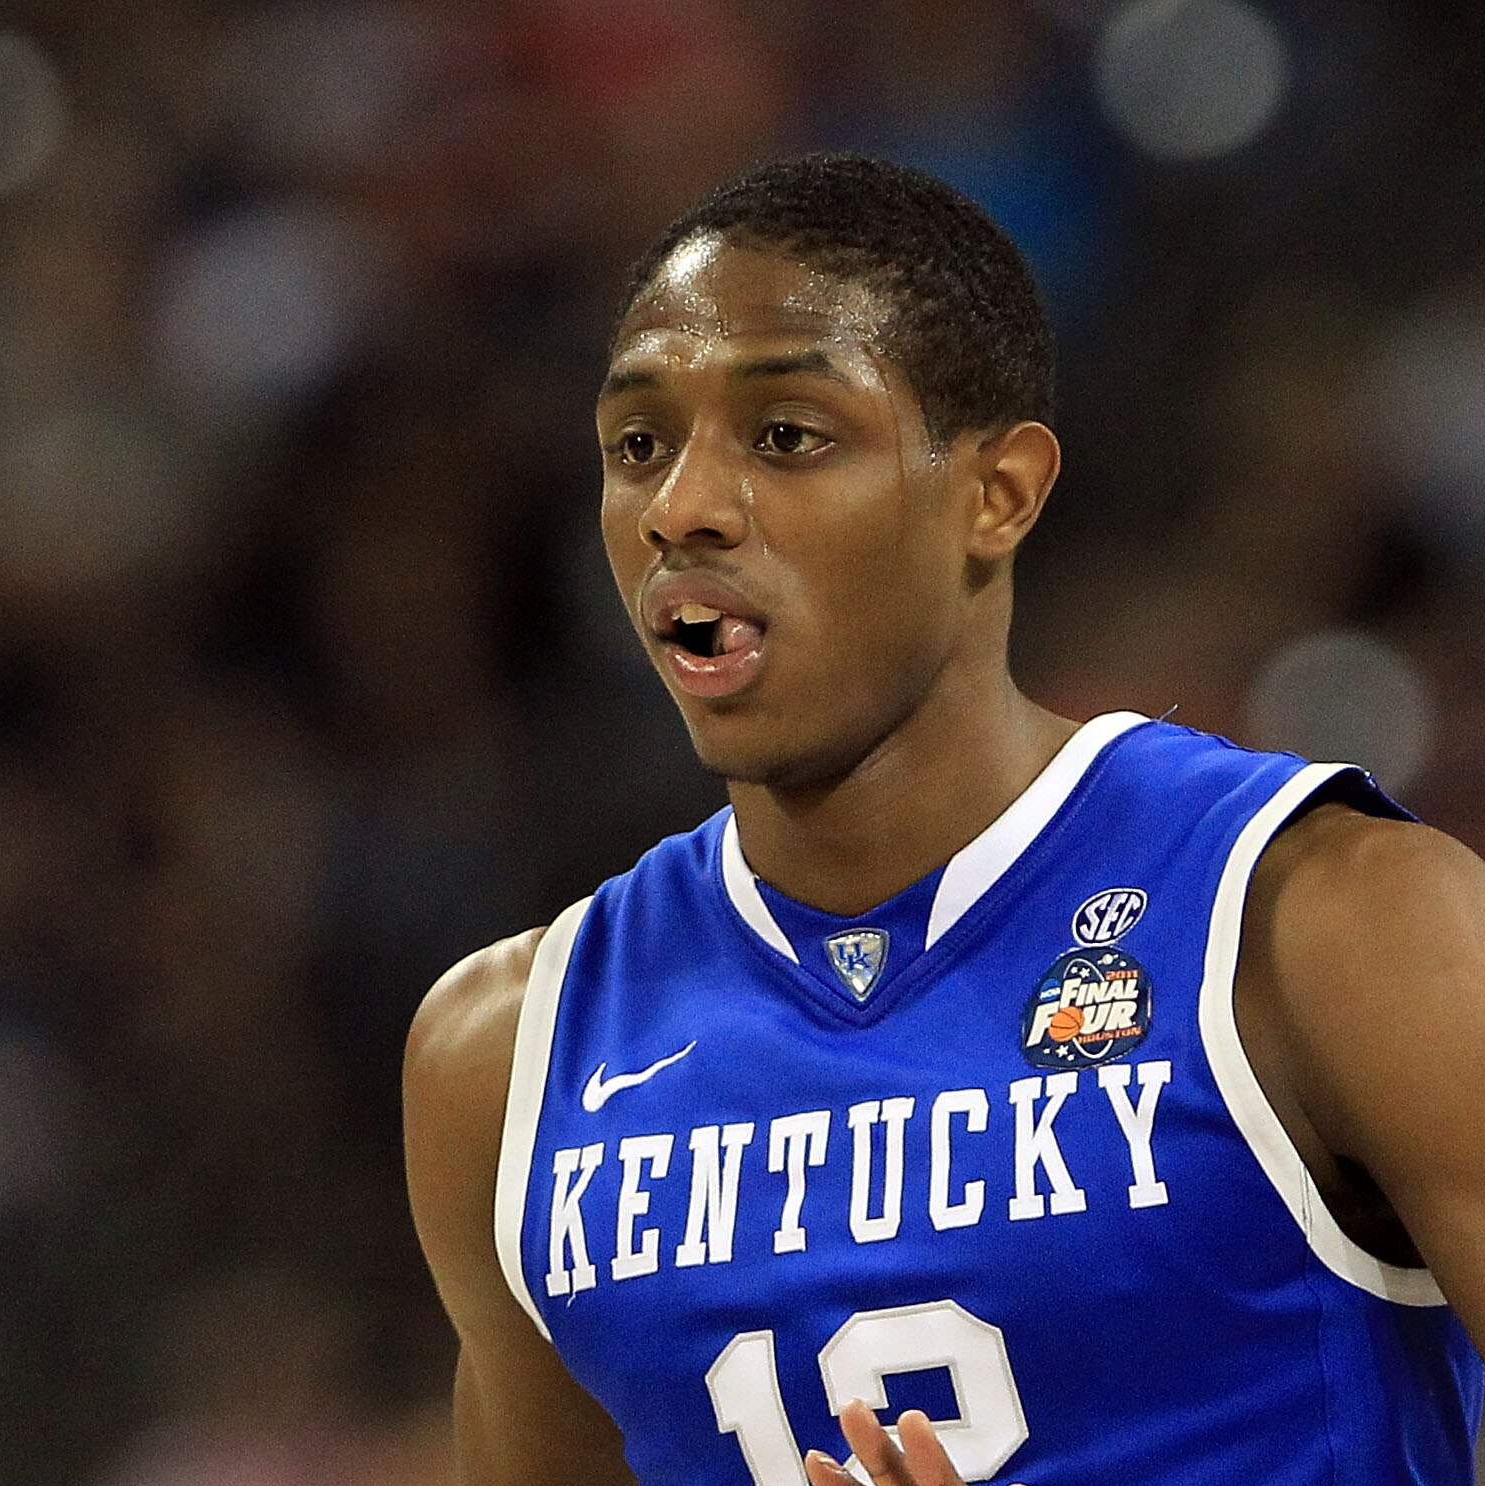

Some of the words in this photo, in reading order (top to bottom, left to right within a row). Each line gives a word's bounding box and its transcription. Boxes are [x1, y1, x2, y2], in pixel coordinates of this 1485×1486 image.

[1079, 893, 1141, 941] SEC
[1059, 977, 1139, 1008] FINAL
[1105, 969, 1139, 981] 2011
[544, 1060, 1172, 1298] KENTUCKY
